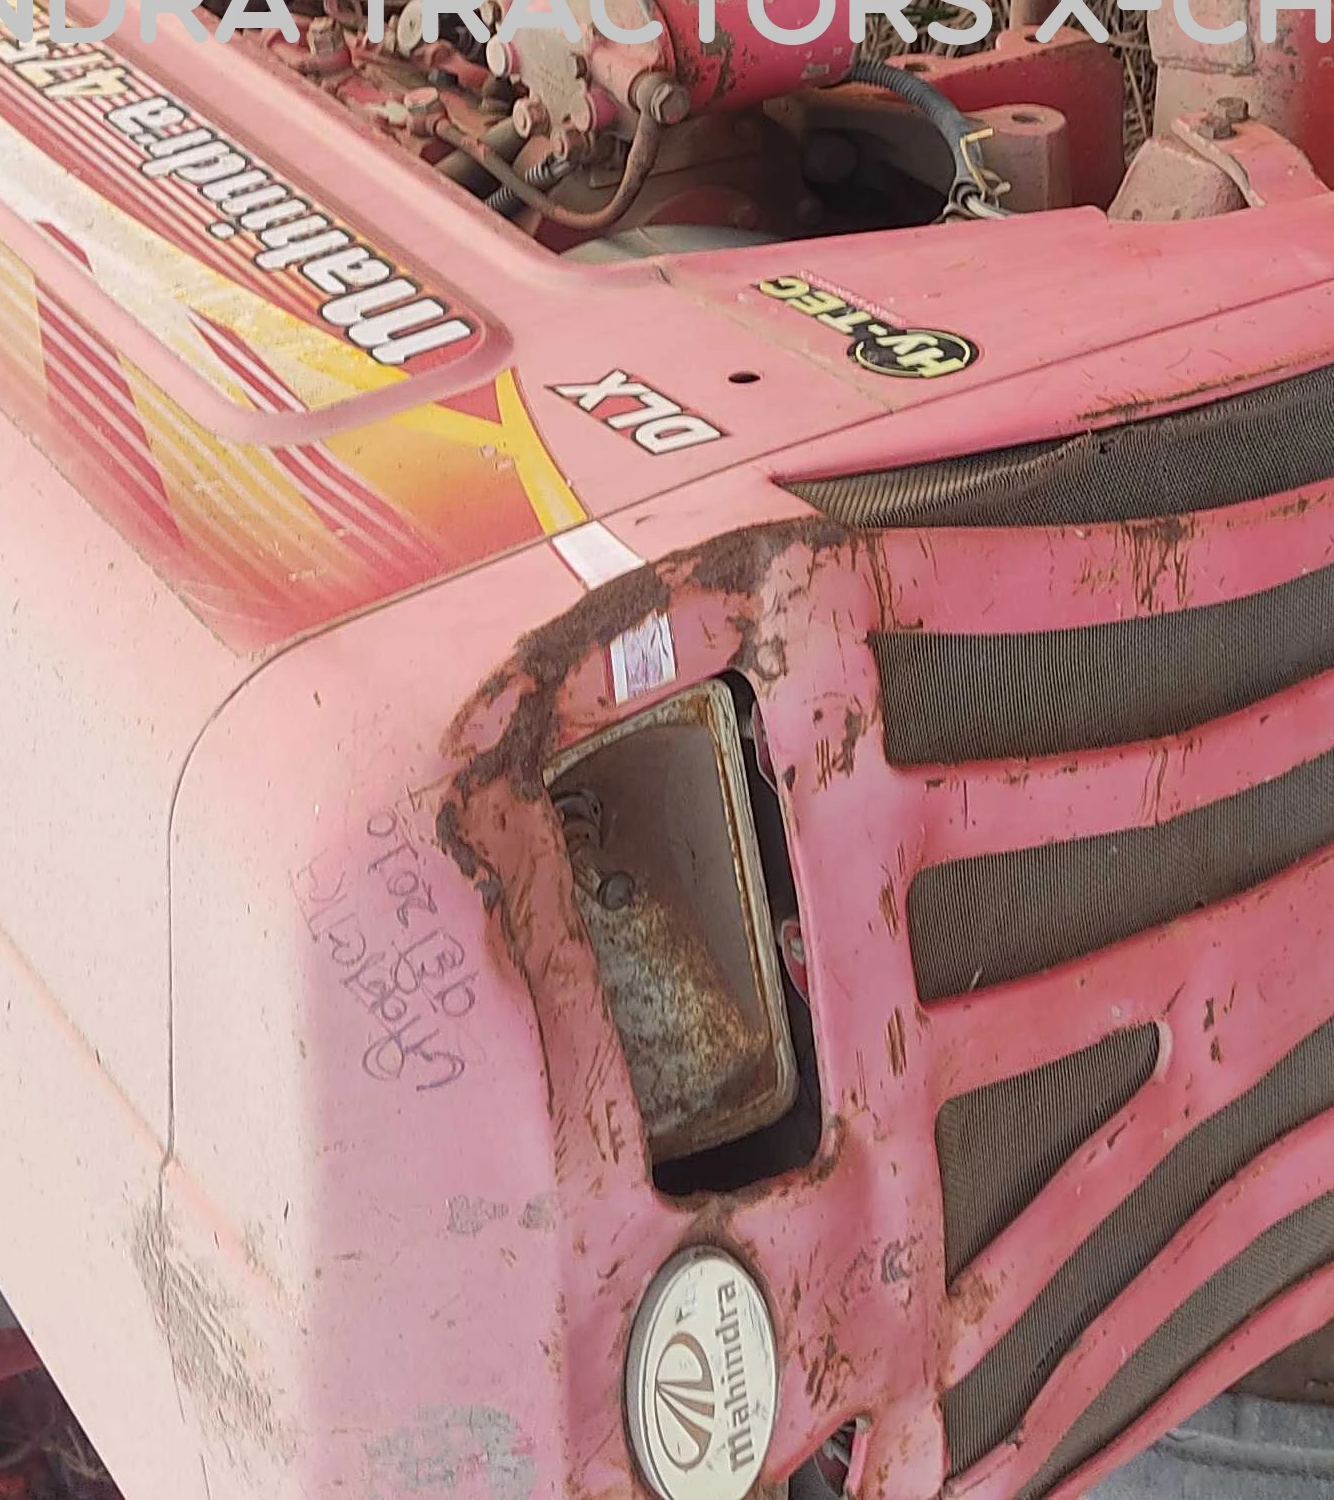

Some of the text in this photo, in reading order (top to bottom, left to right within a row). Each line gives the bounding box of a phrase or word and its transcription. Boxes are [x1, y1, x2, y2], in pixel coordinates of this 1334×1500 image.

[104, 96, 471, 363] Mahindra
[549, 369, 724, 453] DLX
[713, 1278, 755, 1470] Mahindra
